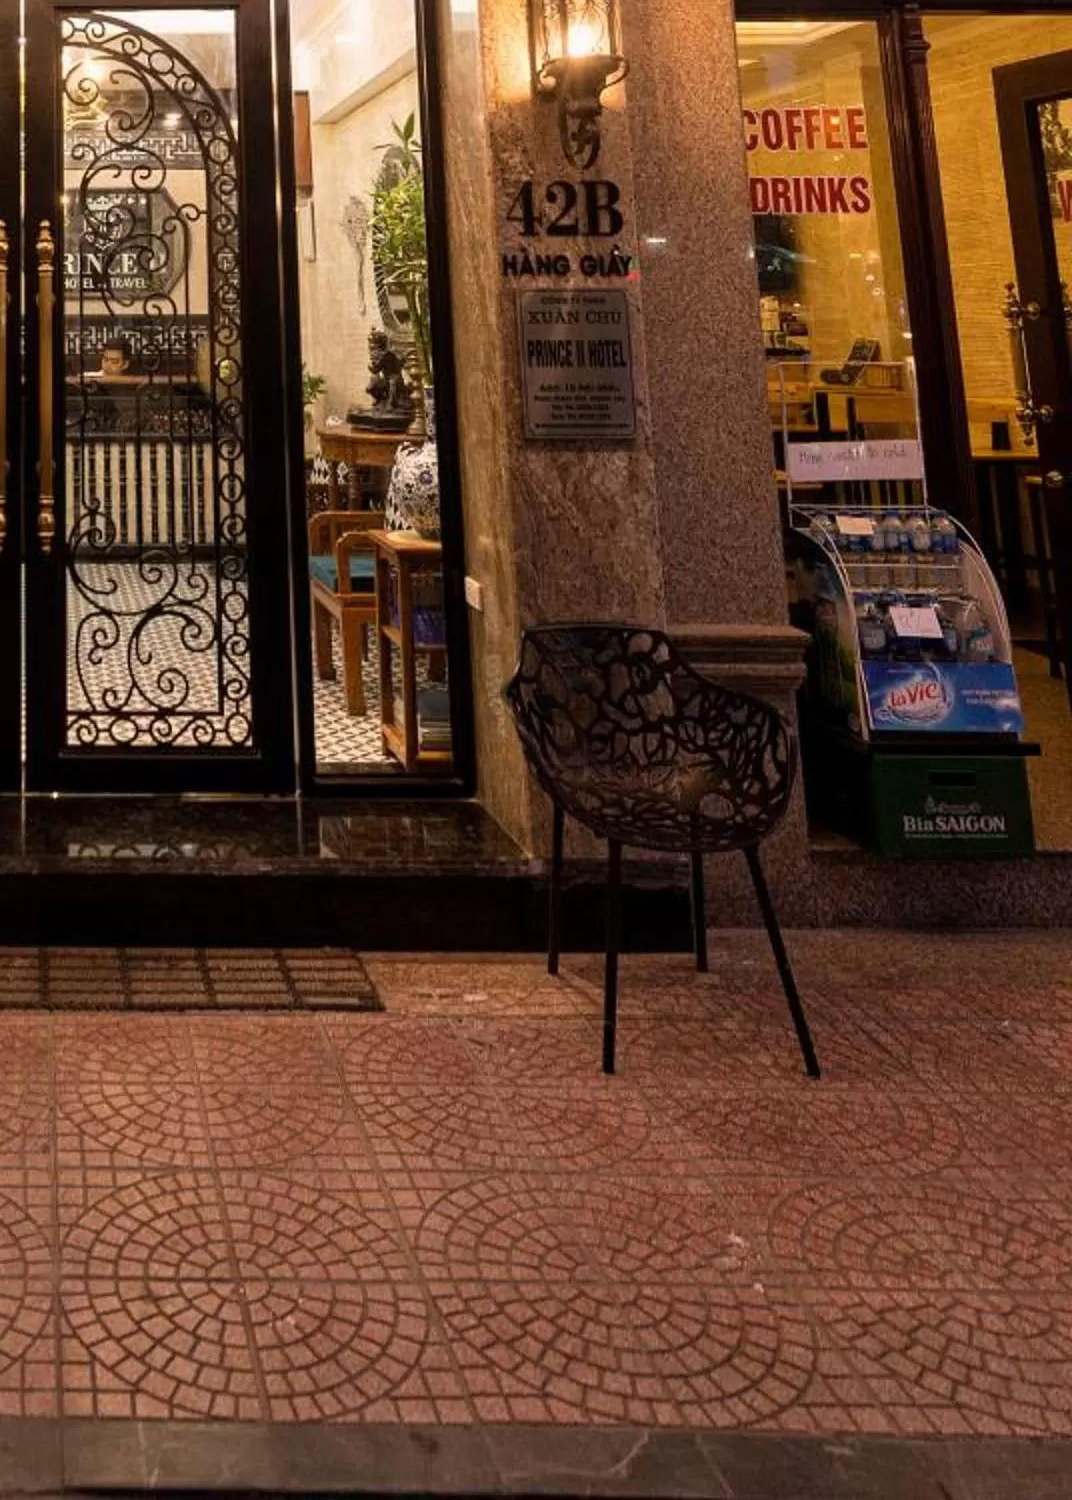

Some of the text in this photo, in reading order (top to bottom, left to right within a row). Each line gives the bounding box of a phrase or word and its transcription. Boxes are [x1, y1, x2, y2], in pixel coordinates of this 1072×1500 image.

[742, 107, 868, 151] COFFEE
[506, 180, 624, 237] 42B
[749, 176, 872, 215] DRINKS
[502, 243, 571, 277] HÀNG
[110, 278, 147, 289] TRAVEL
[528, 340, 574, 368] PRINCE
[588, 340, 628, 368] HOTEL
[935, 815, 1006, 832] SAIGON
